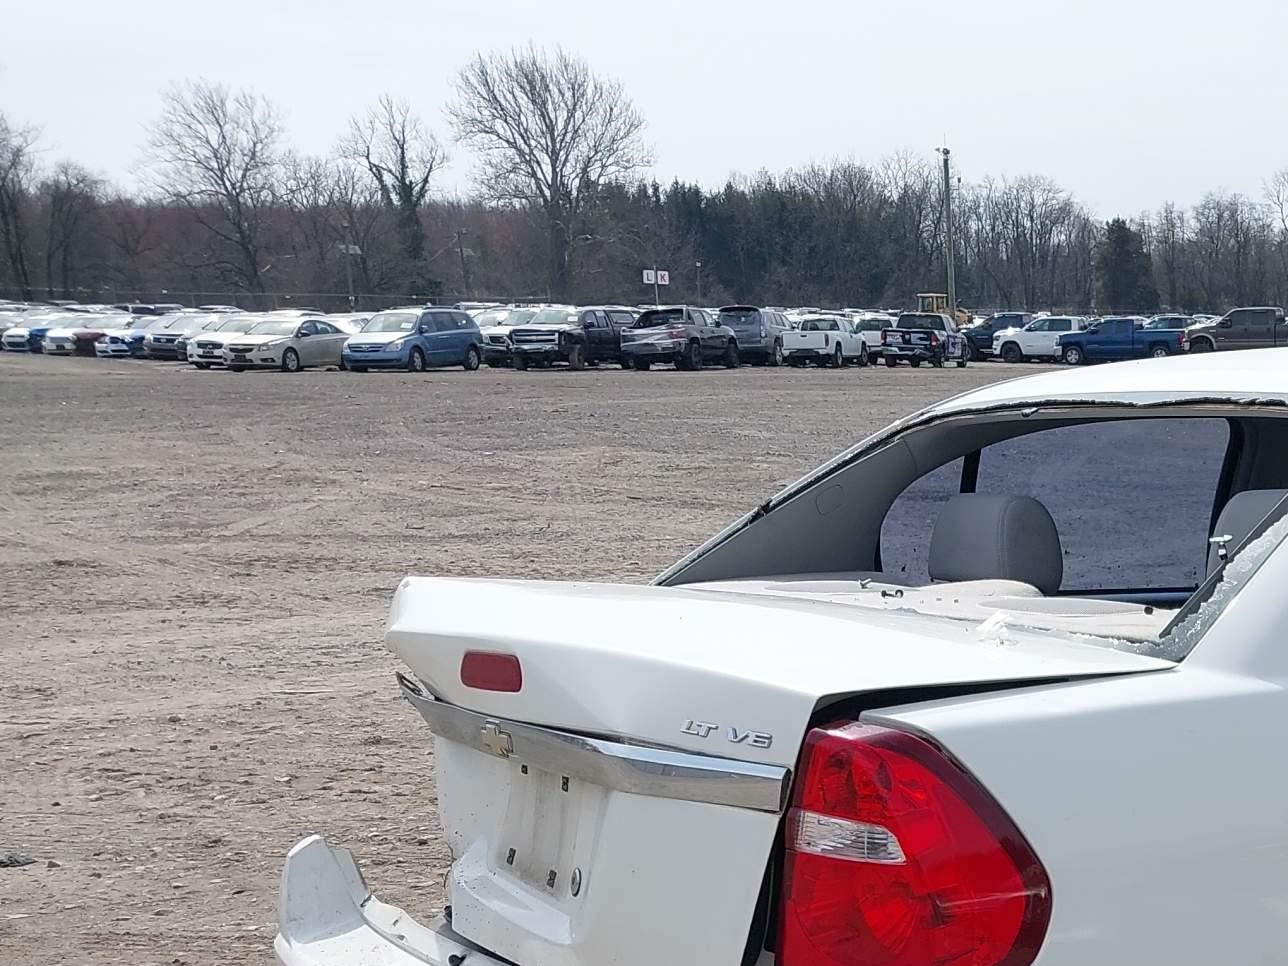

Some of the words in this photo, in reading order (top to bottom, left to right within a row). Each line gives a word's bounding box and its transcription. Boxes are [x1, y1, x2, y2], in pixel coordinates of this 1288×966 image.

[660, 273, 667, 283] K
[680, 720, 719, 738] LT
[727, 727, 773, 749] V6
